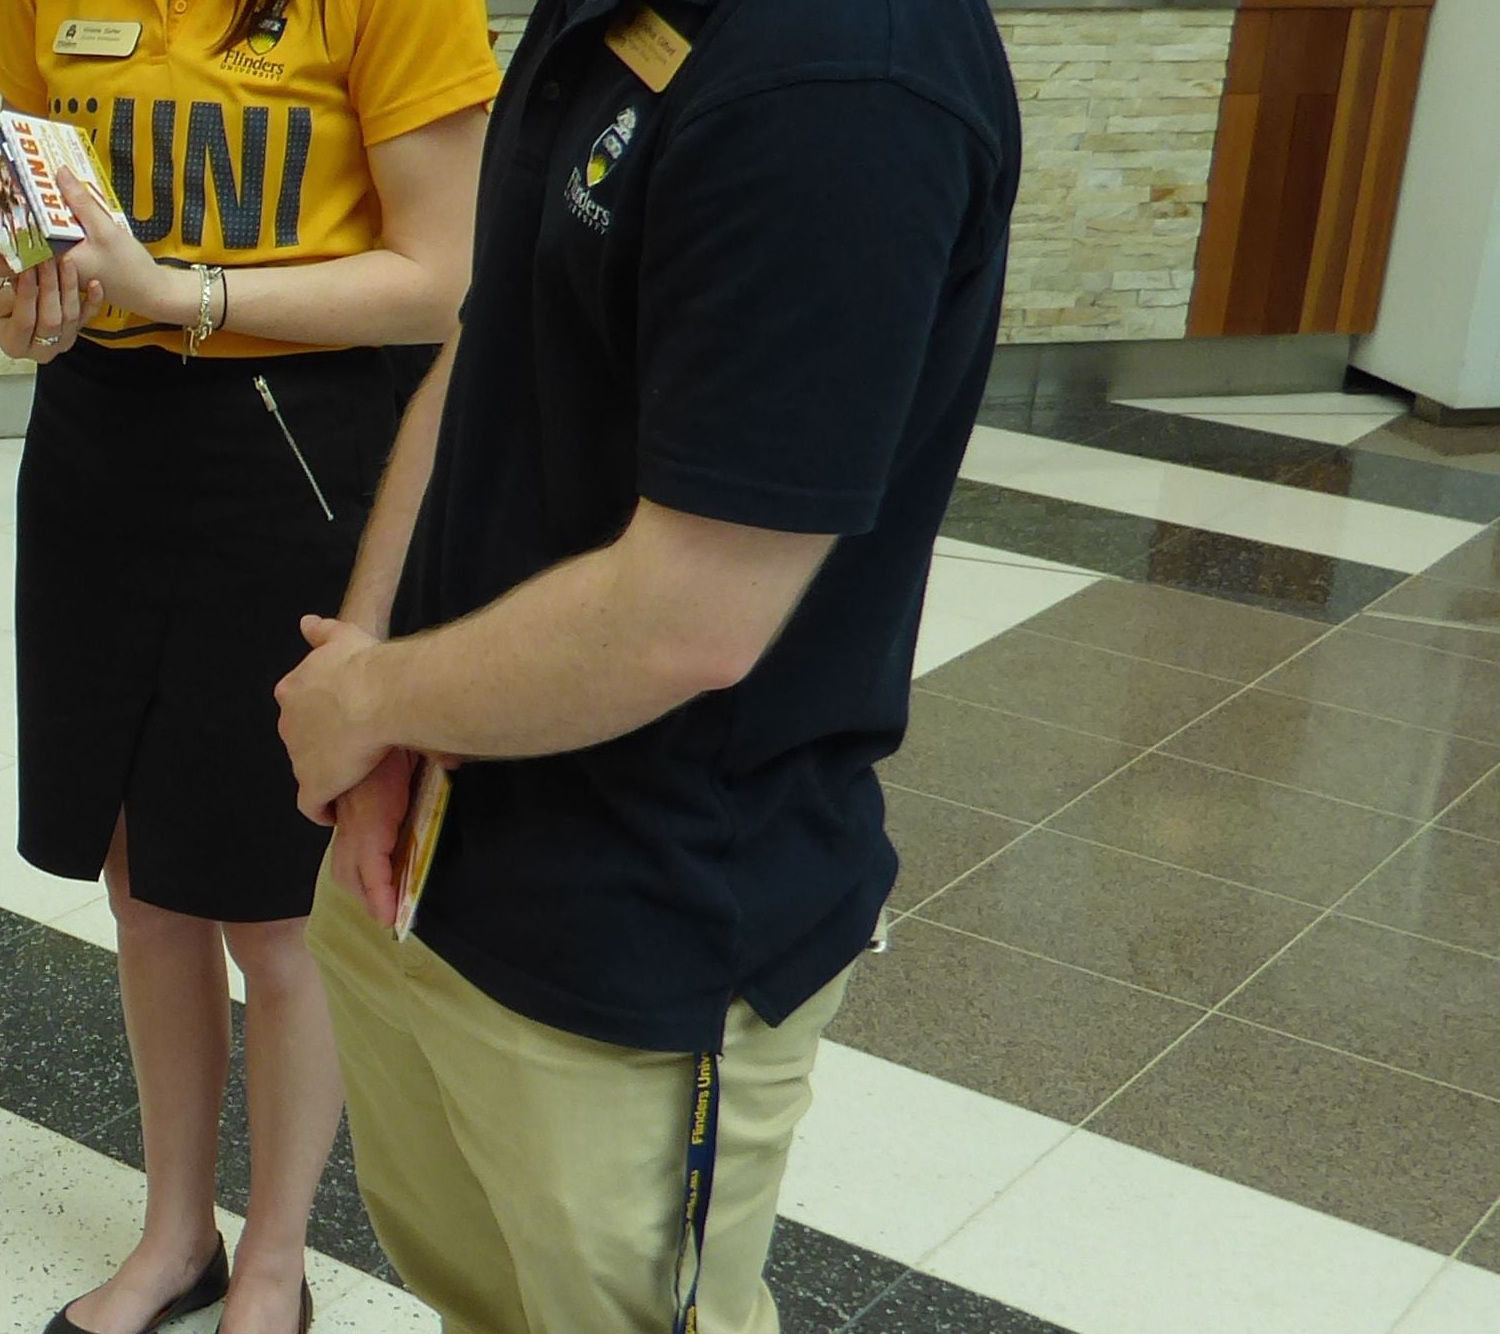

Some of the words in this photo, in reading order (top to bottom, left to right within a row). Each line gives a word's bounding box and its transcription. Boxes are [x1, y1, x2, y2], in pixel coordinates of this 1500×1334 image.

[222, 49, 285, 75] Flinders
[11, 119, 70, 228] FRINGE
[108, 97, 312, 250] UNI
[691, 1088, 709, 1146] Flinders
